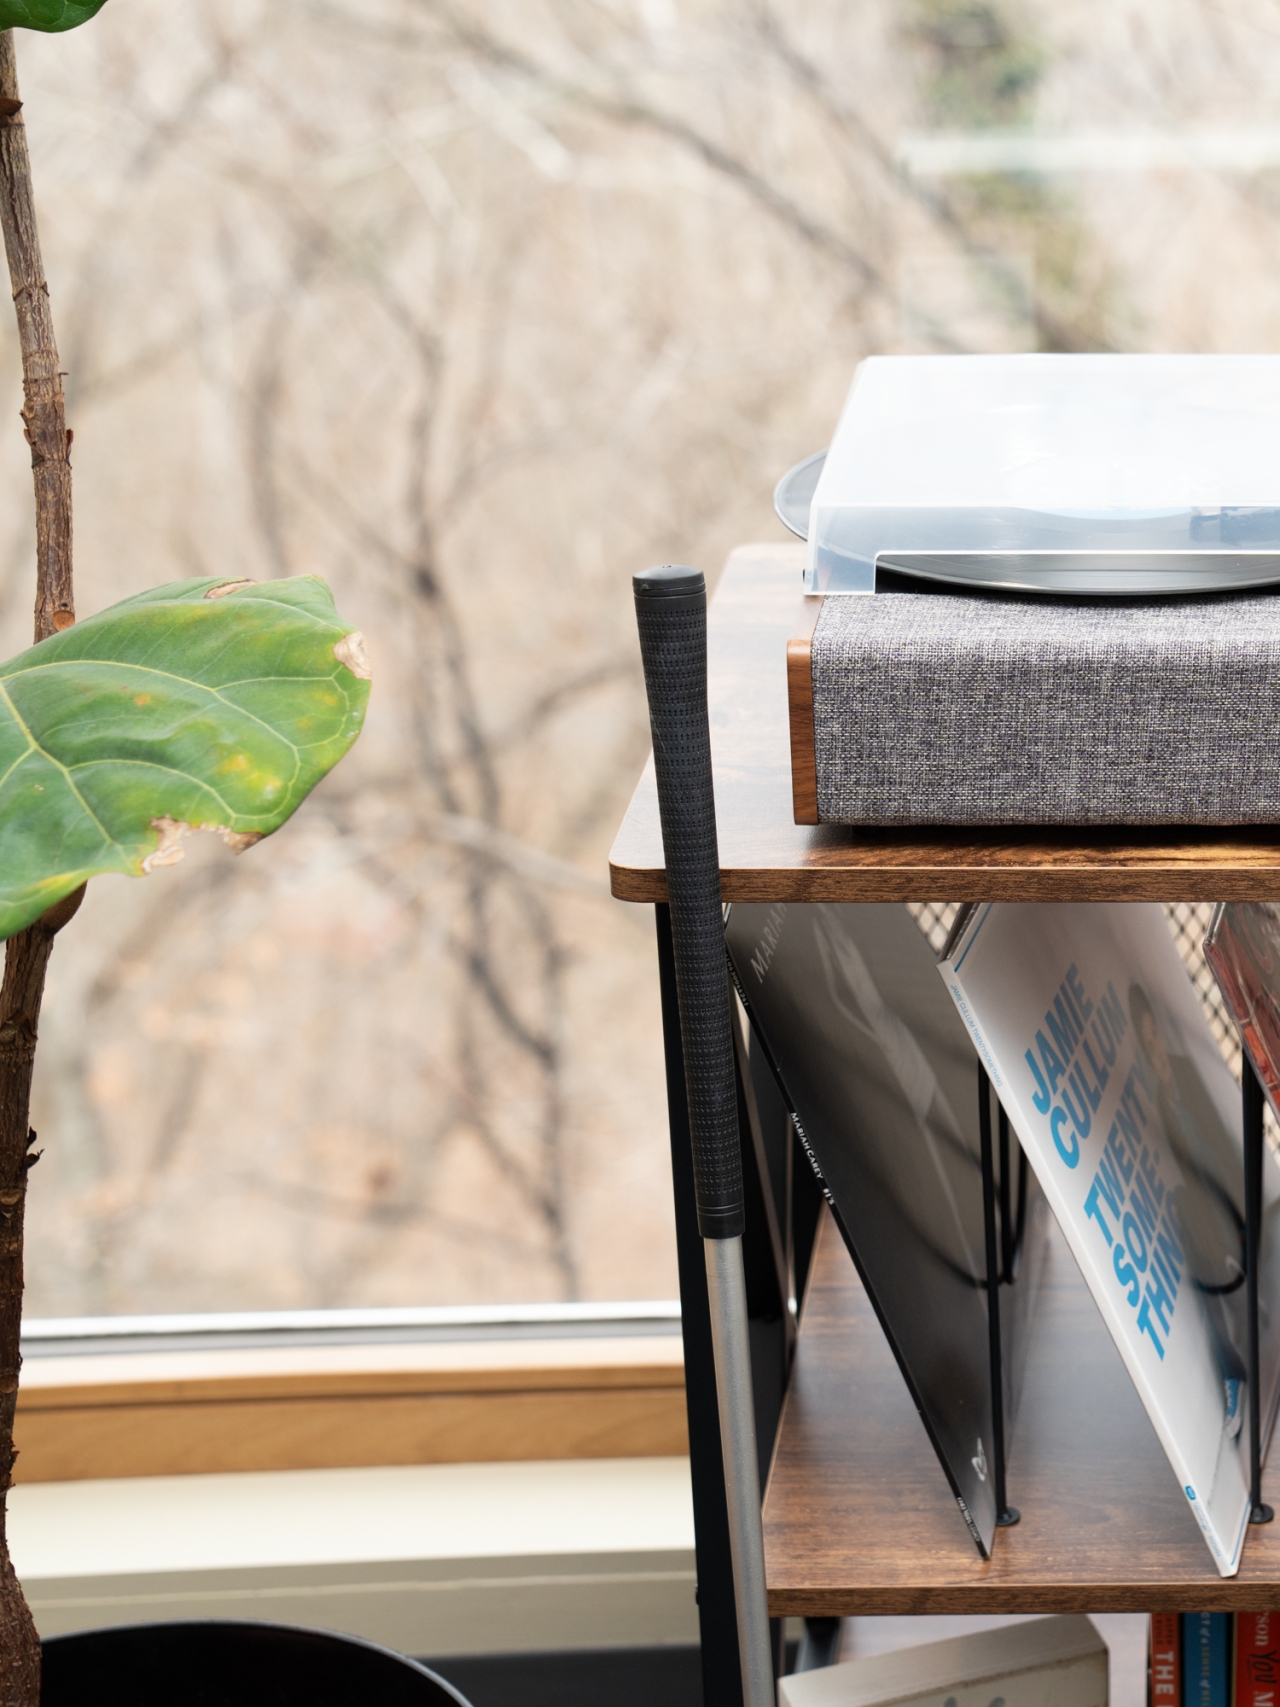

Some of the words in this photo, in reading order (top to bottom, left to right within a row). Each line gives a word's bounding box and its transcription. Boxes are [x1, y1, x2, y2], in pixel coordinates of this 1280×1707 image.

[950, 984, 964, 1003] JAMIE
[959, 1001, 976, 1029] CULLUM
[1024, 961, 1094, 1116] JAMIE
[1050, 979, 1129, 1170] CULLUM
[790, 1112, 811, 1150] MARIAH
[806, 1149, 824, 1179] CAREY
[1155, 1651, 1175, 1695] THE
[1250, 1650, 1280, 1684] You
